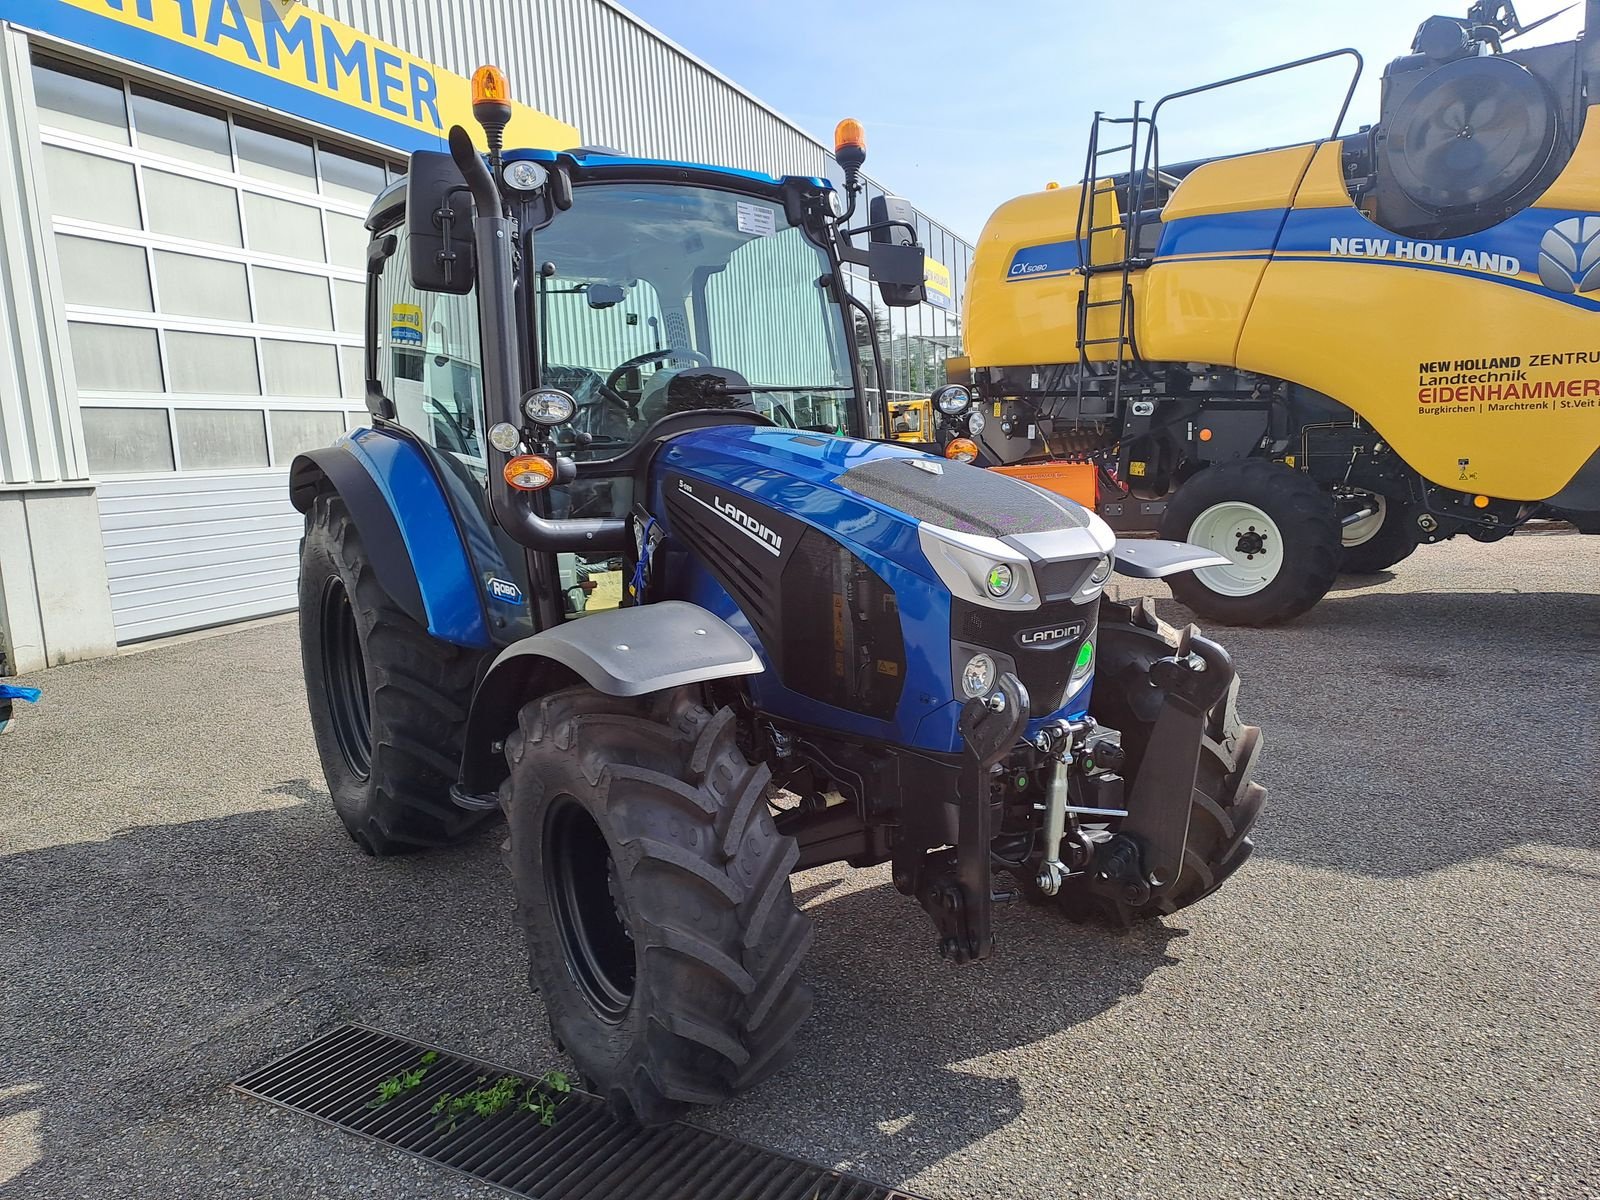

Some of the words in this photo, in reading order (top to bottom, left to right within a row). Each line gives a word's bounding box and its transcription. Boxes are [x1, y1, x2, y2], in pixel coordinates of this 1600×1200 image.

[1329, 237, 1390, 257] NEW
[1394, 240, 1521, 277] HOLLAND
[1419, 361, 1451, 374] NEW
[1454, 356, 1521, 372] HOLLAND
[1419, 370, 1527, 386] Landtechnik
[1418, 379, 1600, 404] EIDENHAMMER
[1418, 404, 1476, 415] Burgkirchen
[1488, 401, 1549, 412] Marchtrenk
[1560, 399, 1595, 409] St.Veit
[714, 495, 783, 549] LANDINI
[493, 581, 516, 596] ROBO
[1021, 625, 1080, 643] LANDINI
